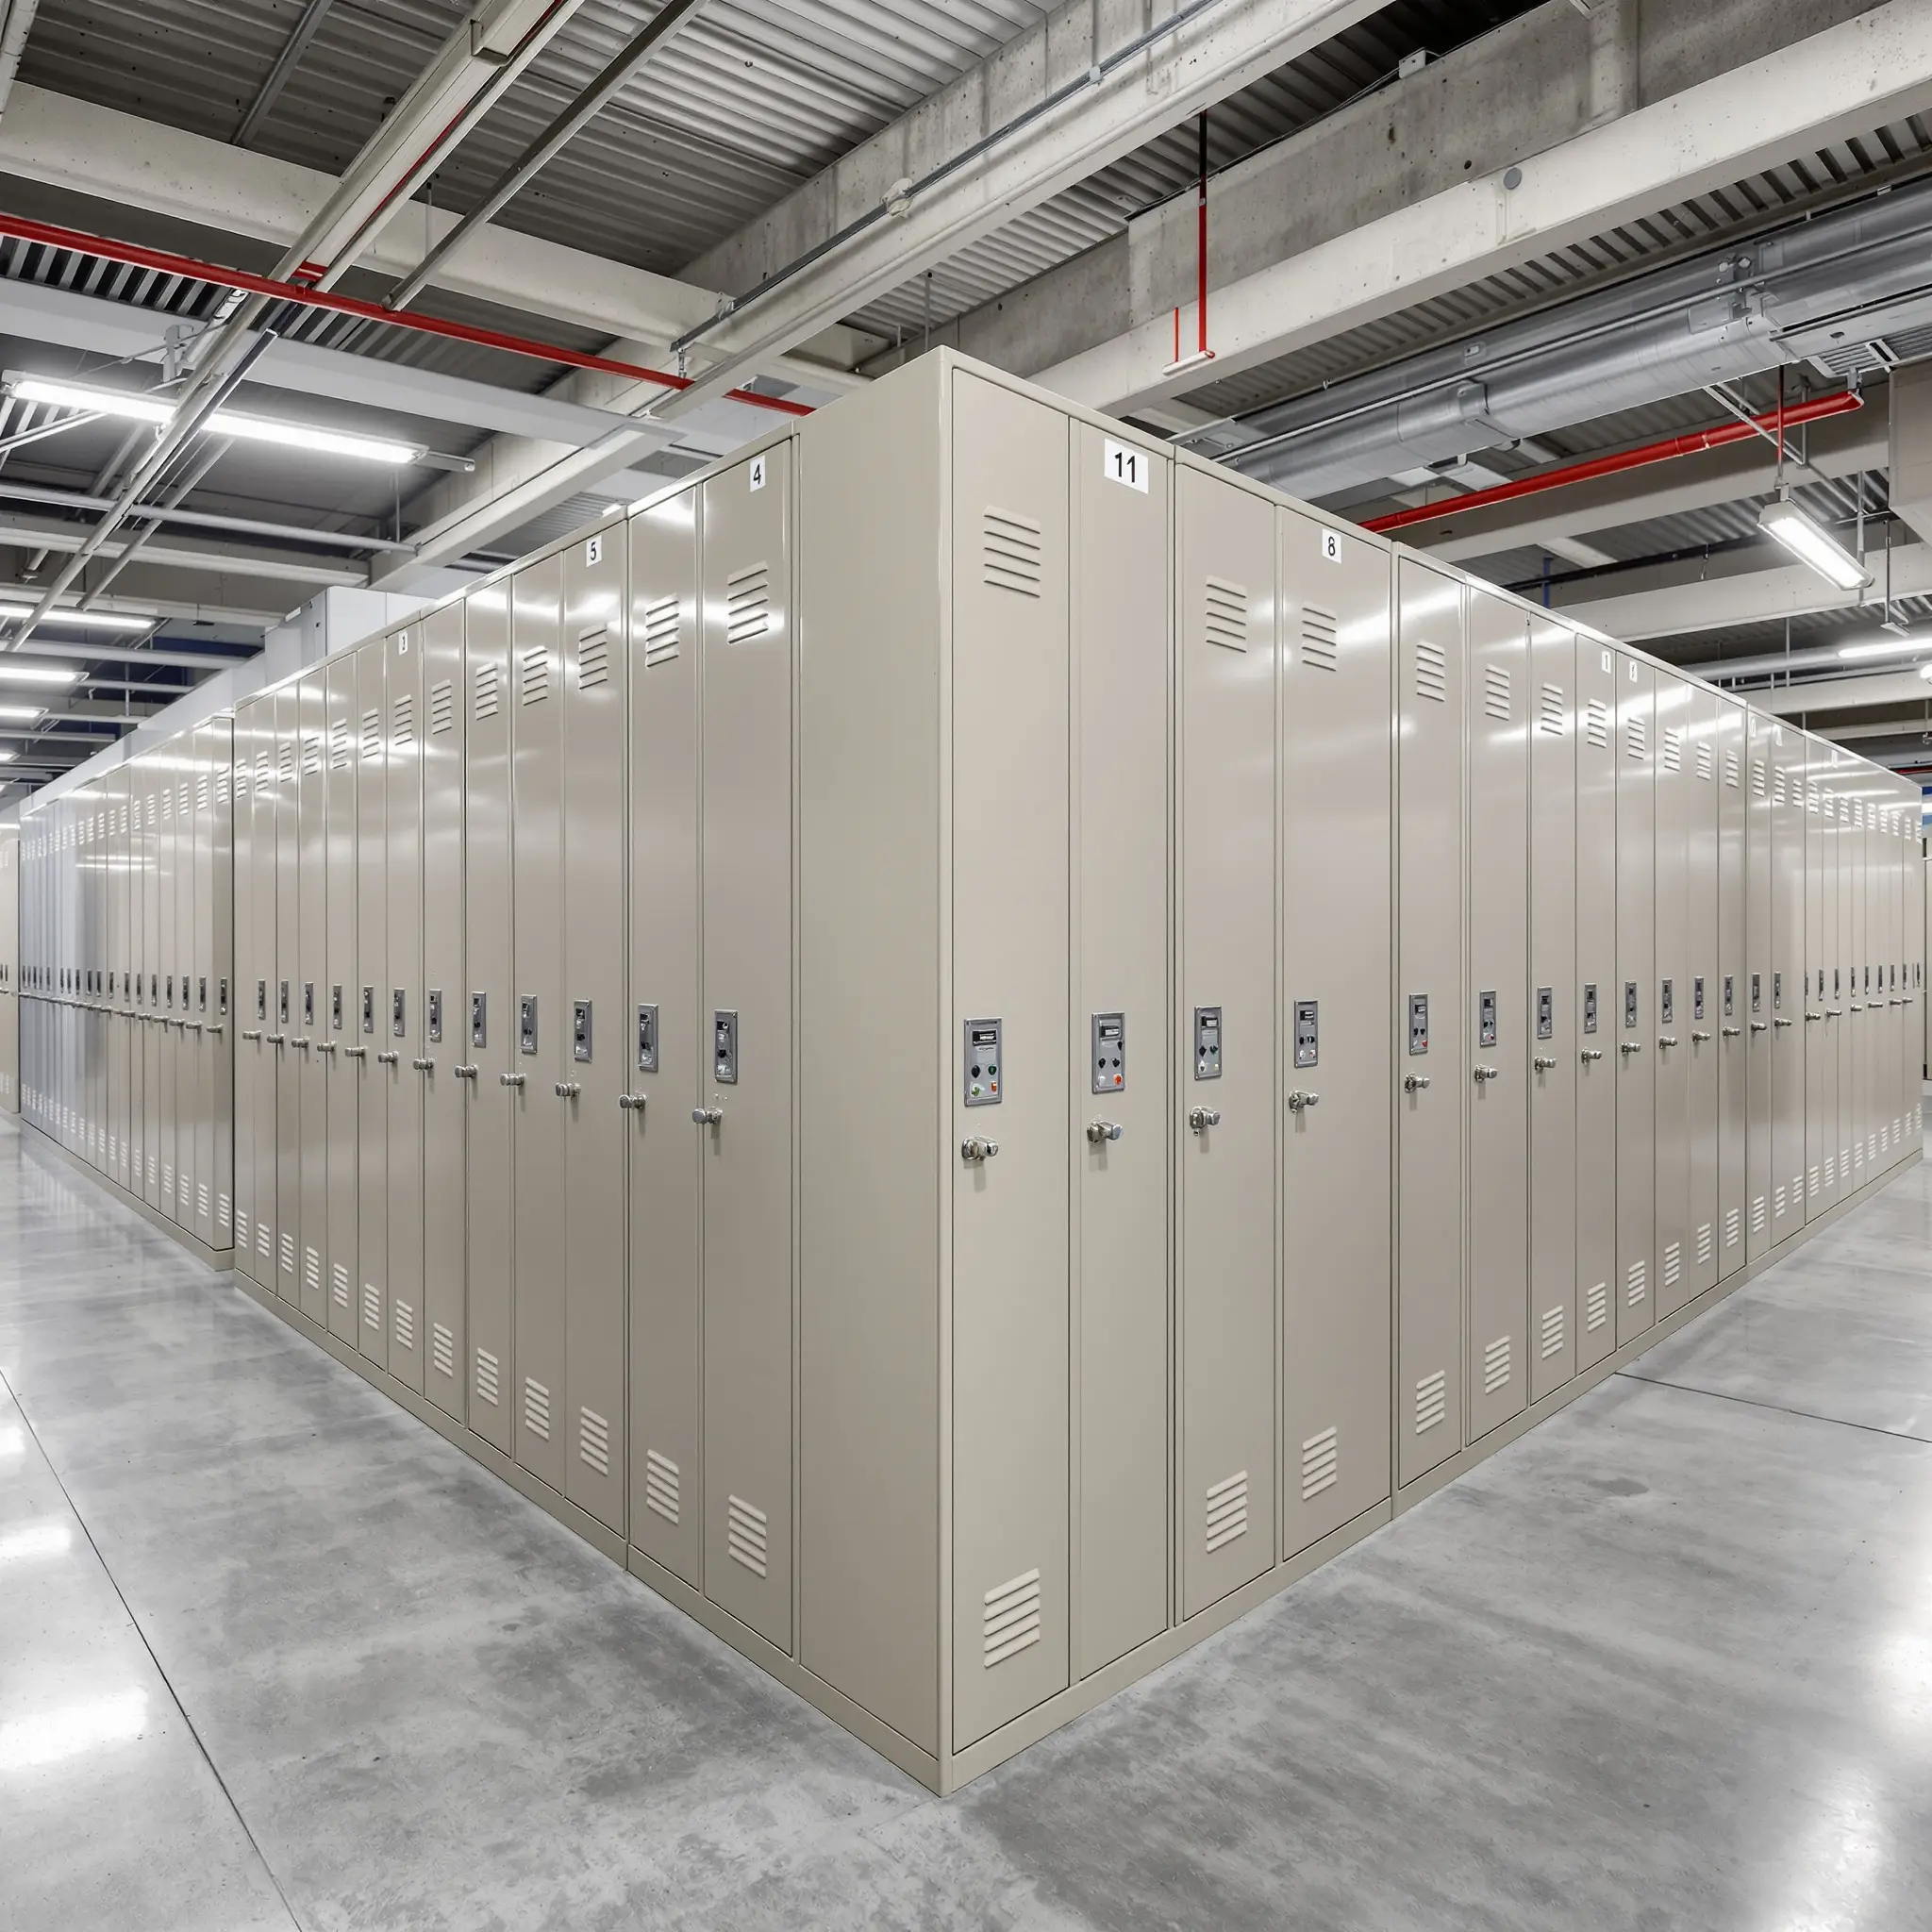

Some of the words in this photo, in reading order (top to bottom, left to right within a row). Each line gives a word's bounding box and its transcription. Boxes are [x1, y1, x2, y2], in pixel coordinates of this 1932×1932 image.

[753, 463, 761, 485] 4
[1114, 452, 1135, 483] 11
[591, 541, 597, 561] 5
[1328, 536, 1336, 557] 8
